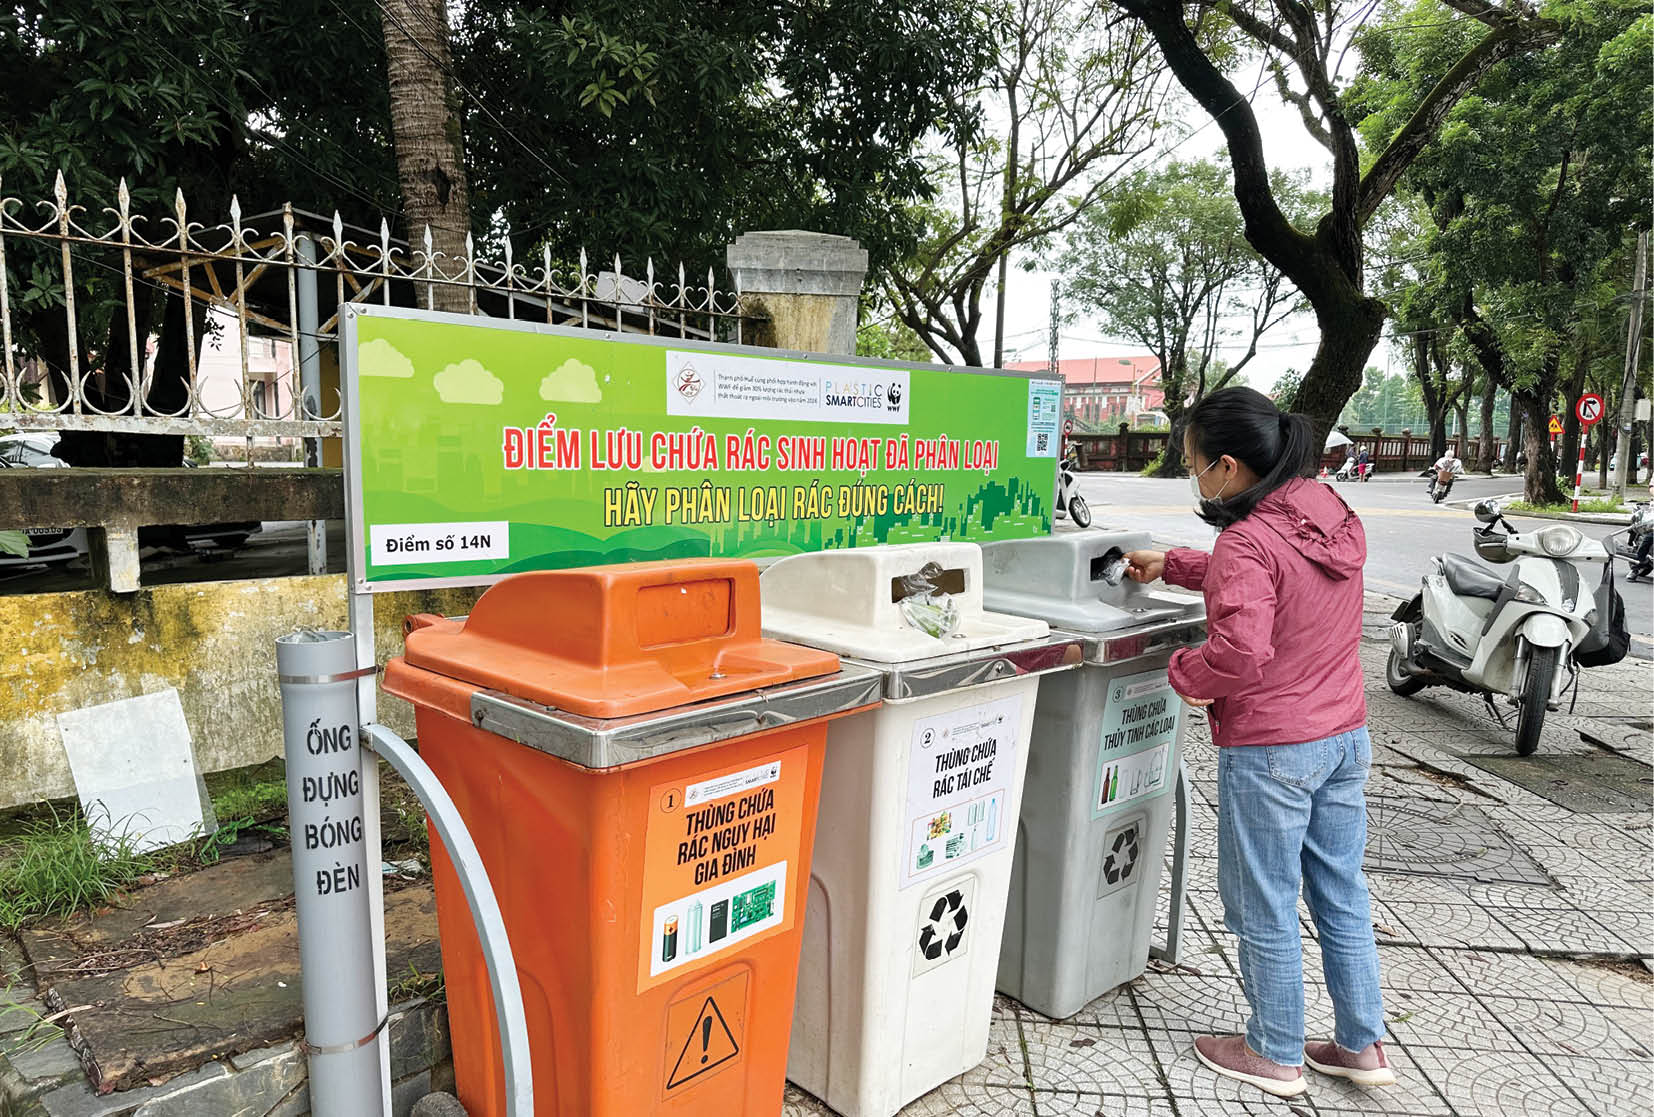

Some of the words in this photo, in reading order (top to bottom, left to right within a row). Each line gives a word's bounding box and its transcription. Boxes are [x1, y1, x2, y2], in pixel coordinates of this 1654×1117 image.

[825, 381, 883, 397] PLASTIC
[825, 394, 882, 409] SMARTCITIES
[887, 405, 900, 413] WWF
[503, 413, 581, 469] ĐIỂM
[591, 427, 642, 470] LƯU
[651, 427, 718, 470] CHỨA
[726, 428, 770, 470] RÁC
[777, 435, 826, 470] SINH
[832, 438, 881, 476] HOẠT
[885, 434, 909, 470] ĐÃ
[914, 434, 959, 470] PHÂN
[964, 440, 999, 475] LOẠI
[604, 480, 658, 527] HÃY
[665, 479, 731, 525] PHÂN
[738, 486, 787, 528] LOẠI
[793, 479, 832, 520] RÁC
[837, 479, 888, 518] ĐÚNG
[893, 478, 944, 516] CÁCH!
[386, 534, 430, 552] Điểm
[435, 535, 455, 550] số
[461, 535, 491, 549] 14N
[1115, 690, 1121, 699] 3
[1121, 704, 1147, 725] THÙNG
[1148, 698, 1166, 718] CHỨA
[306, 718, 352, 755] ỐNG
[923, 732, 931, 744] 2
[1104, 728, 1125, 751] THỦY
[1127, 724, 1144, 745] TINH
[1144, 721, 1158, 739] CÁC
[1159, 715, 1176, 734] LOẠI
[935, 748, 971, 773] THÙNG
[971, 738, 997, 762] CHỨA
[302, 769, 359, 807] ĐỰNG
[932, 774, 954, 799] RÁC
[957, 768, 972, 791] TÁI
[973, 757, 996, 785] CHẾ
[668, 795, 673, 808] 1
[685, 801, 735, 836] THÙNG
[737, 787, 775, 818] CHỨA
[304, 815, 362, 850] BÓNG
[677, 835, 708, 865] RÁC
[711, 821, 750, 855] NGUY
[752, 813, 776, 841] HẠI
[316, 861, 361, 895] ĐÈN
[694, 857, 719, 886] GIA
[722, 844, 757, 876] ĐÌNH
